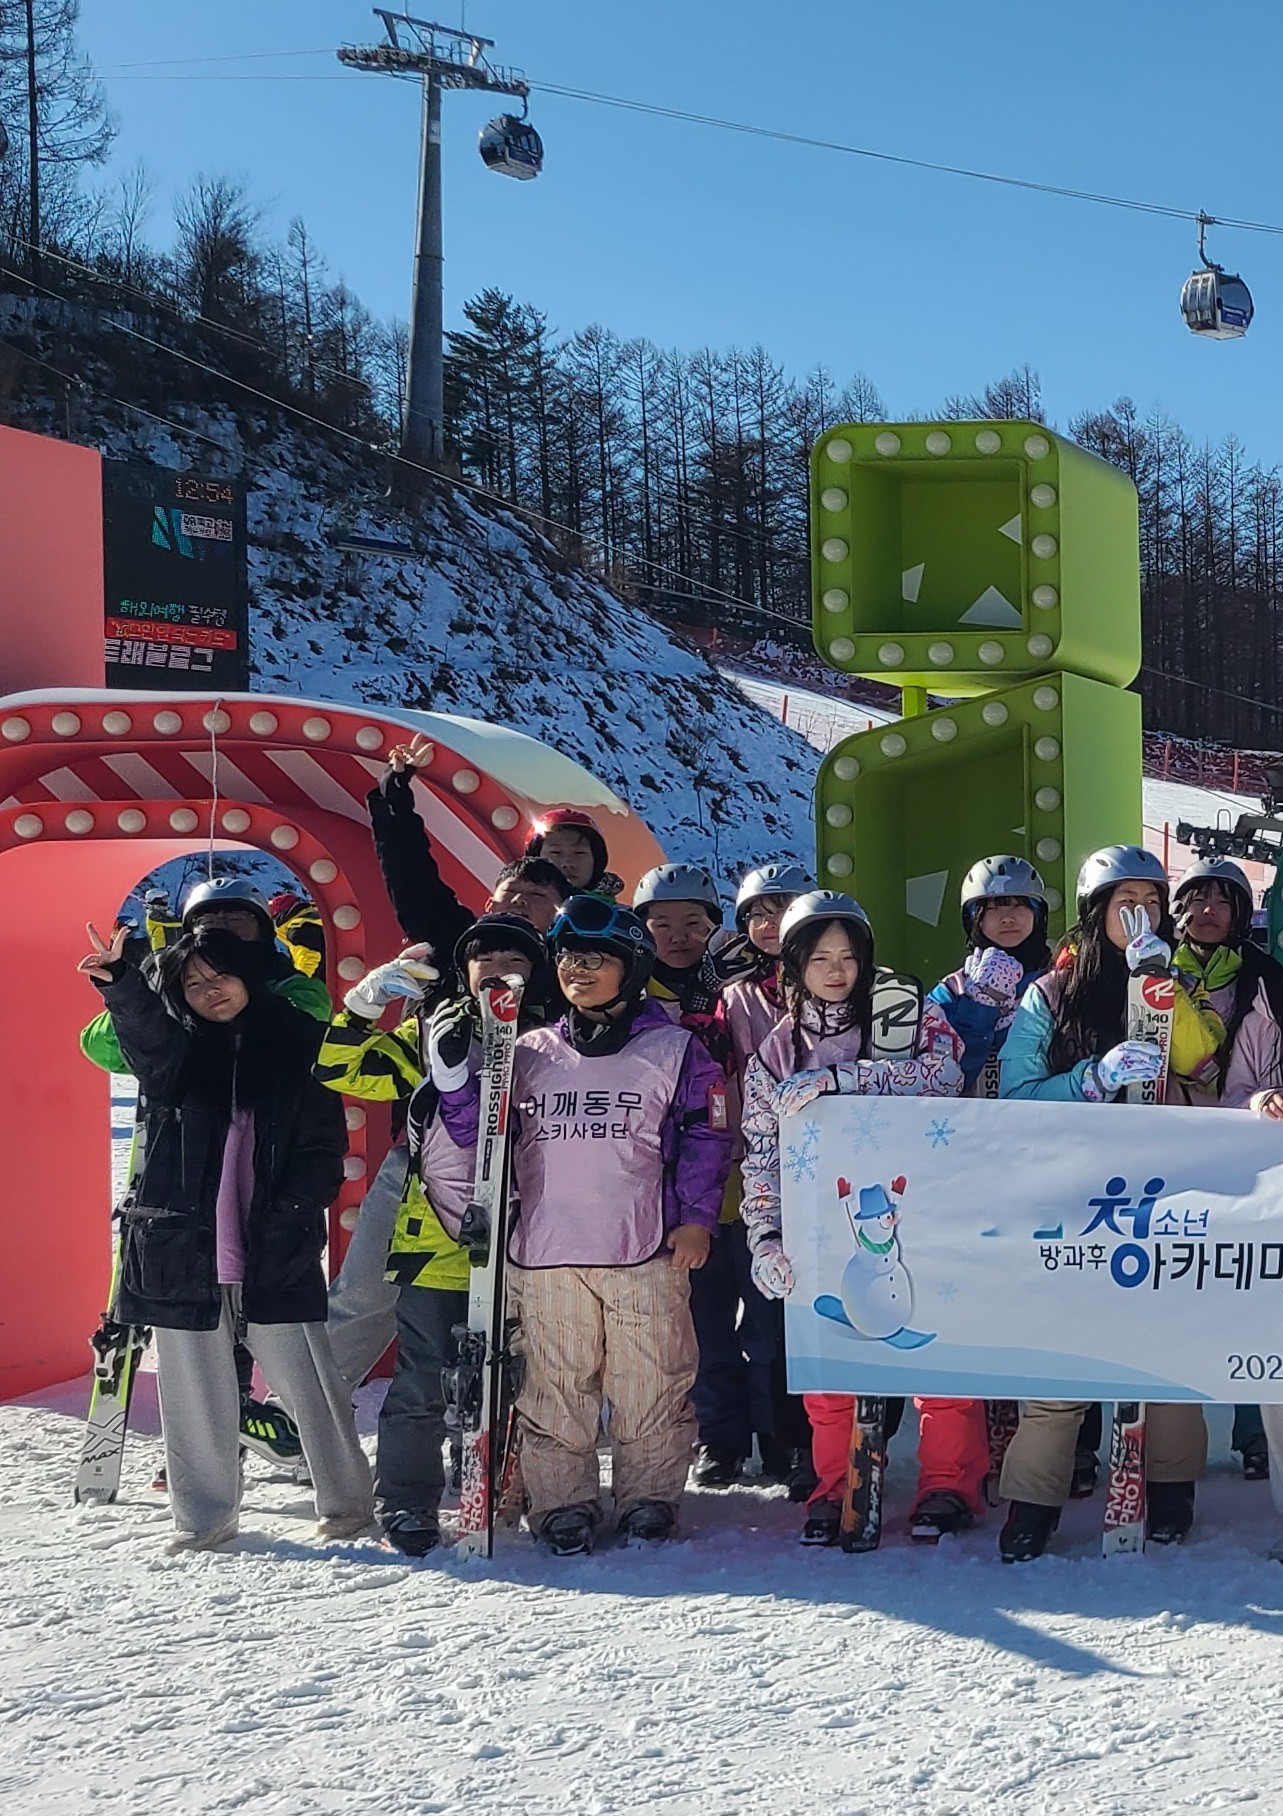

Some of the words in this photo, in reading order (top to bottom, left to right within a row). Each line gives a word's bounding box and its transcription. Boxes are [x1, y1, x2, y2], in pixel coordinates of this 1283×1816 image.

[176, 477, 233, 505] 12:54
[120, 600, 185, 622] 해외여행
[1145, 1014, 1169, 1024] 140
[486, 1038, 506, 1136] ROSSIGNOL
[526, 1090, 643, 1118] 어깨동무
[535, 1122, 629, 1141] 스키사업단
[1077, 1176, 1210, 1239] 청소년
[1040, 1243, 1107, 1271] 방과후
[1105, 1469, 1128, 1525] PMC
[1119, 1484, 1139, 1526] PRO
[469, 1493, 484, 1532] PRO
